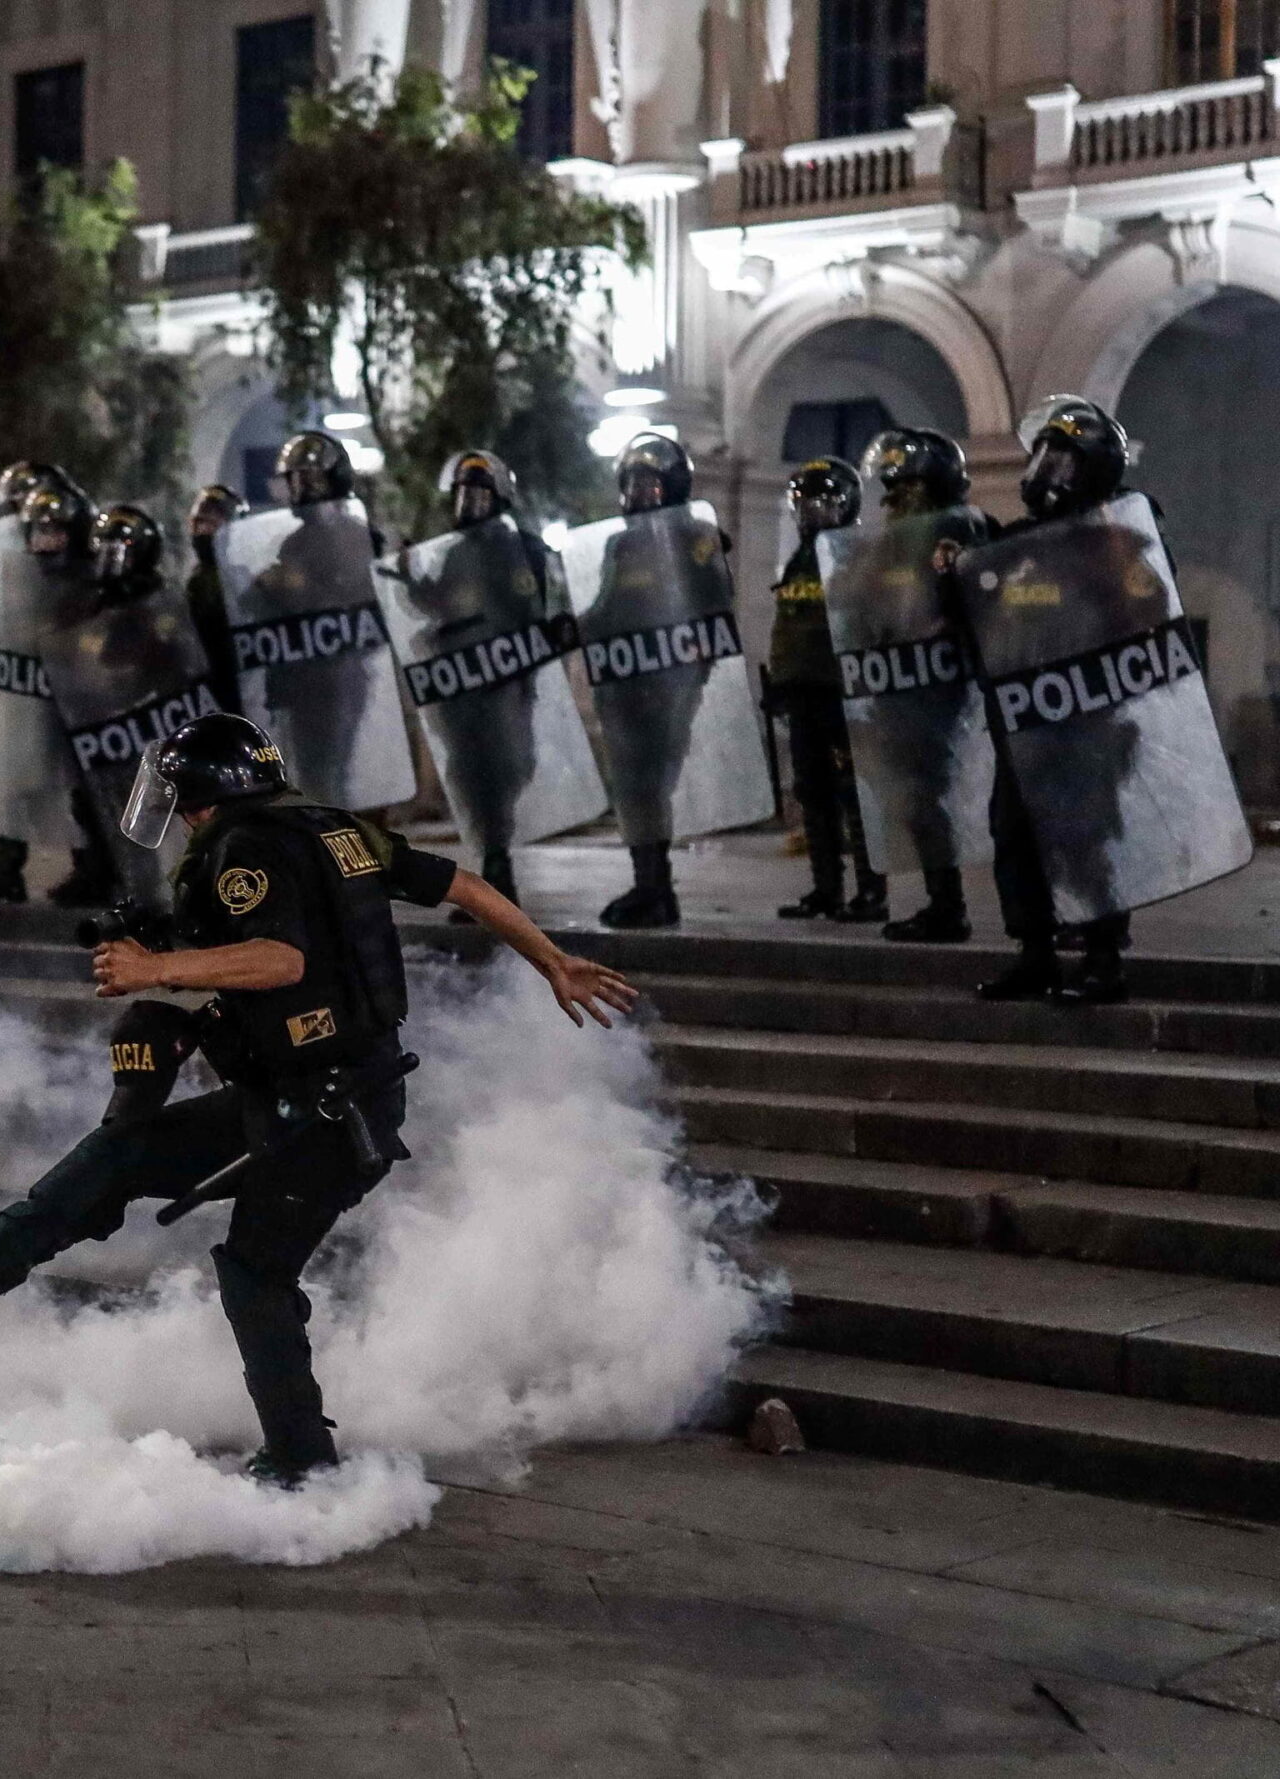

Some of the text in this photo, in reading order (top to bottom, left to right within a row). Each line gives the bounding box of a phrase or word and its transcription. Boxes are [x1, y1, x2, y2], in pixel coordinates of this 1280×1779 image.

[233, 607, 388, 669] POLICIA
[408, 623, 554, 704] POLICIA
[587, 616, 740, 680] POLICIA
[996, 629, 1200, 733] POLICIA
[71, 684, 224, 772] POLICIA
